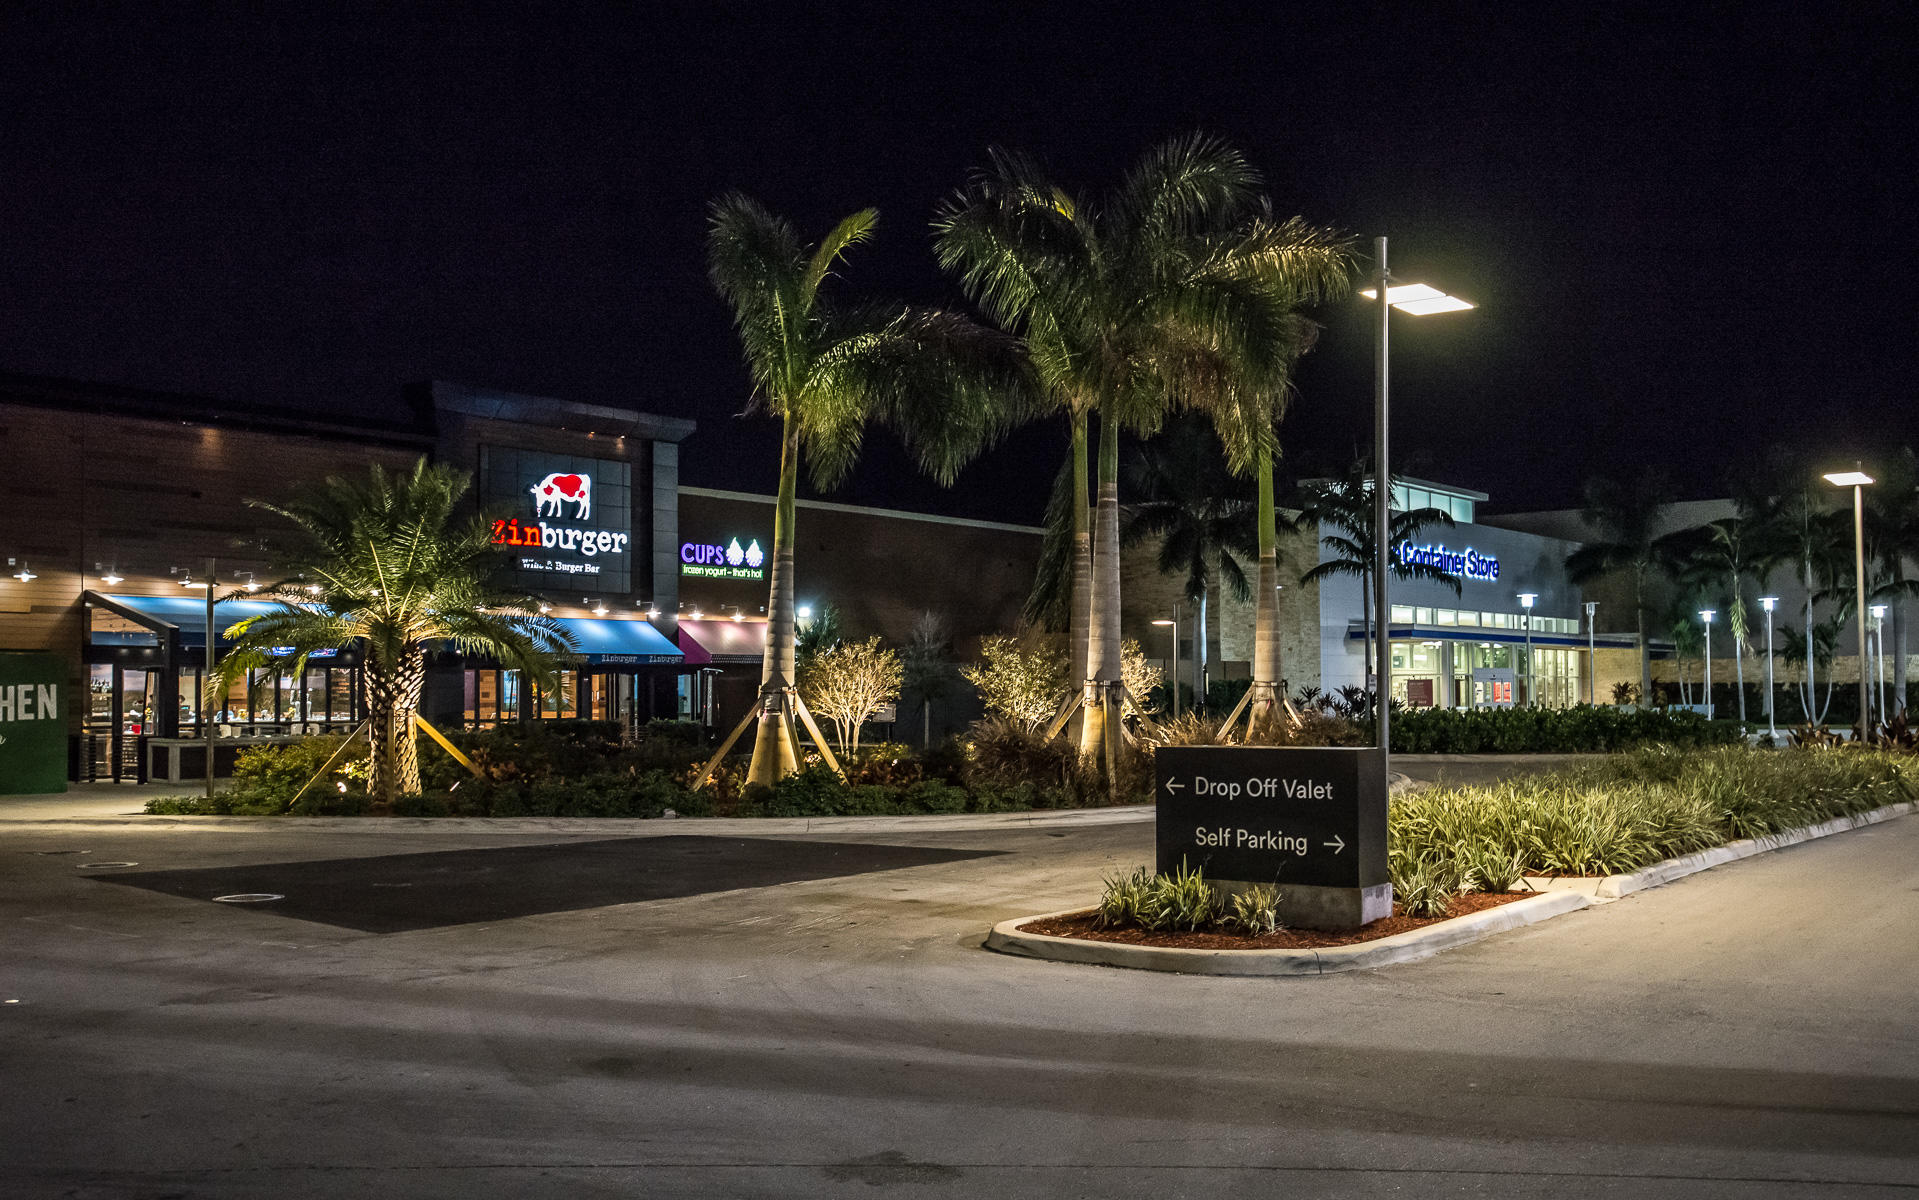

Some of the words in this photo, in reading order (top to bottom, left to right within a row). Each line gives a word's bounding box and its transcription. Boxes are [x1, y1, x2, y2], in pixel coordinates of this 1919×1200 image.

[491, 518, 628, 556] Zinburger
[681, 543, 724, 565] CUPS
[1465, 549, 1500, 580] Store
[555, 561, 583, 573] Burger
[584, 563, 600, 573] Bar
[683, 564, 704, 575] frozen
[705, 567, 727, 577] yogurt
[732, 568, 750, 578] that's
[751, 569, 762, 578] hot
[1195, 776, 1241, 800] Drop
[1246, 778, 1278, 798] Off
[1282, 779, 1333, 800] Valet
[1195, 826, 1231, 846] Self
[1236, 829, 1308, 856] Parking
